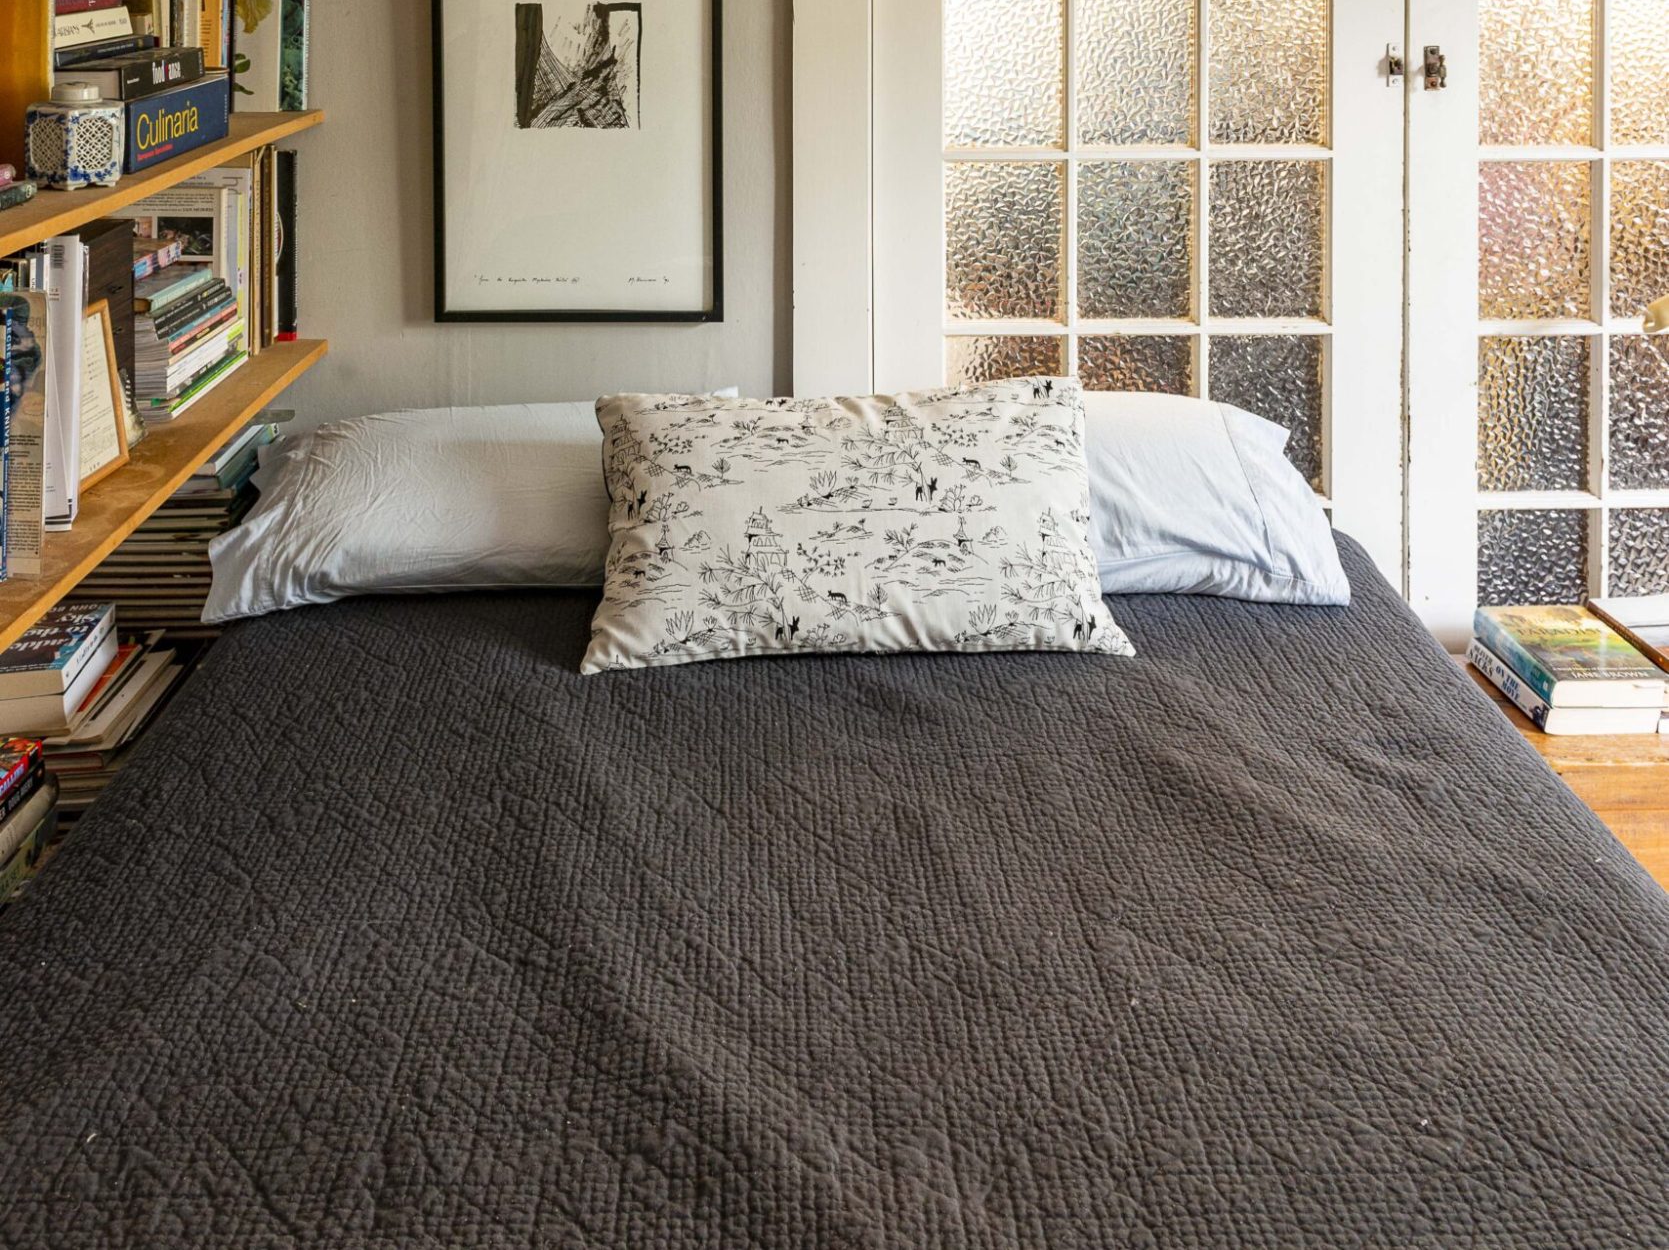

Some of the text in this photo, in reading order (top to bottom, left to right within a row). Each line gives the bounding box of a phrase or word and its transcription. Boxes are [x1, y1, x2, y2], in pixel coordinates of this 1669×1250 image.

[136, 100, 199, 150] Culinaria
[23, 626, 60, 638] the
[1469, 648, 1493, 677] SACKS
[1474, 644, 1493, 664] OLIVER
[1495, 665, 1519, 690] ON THE
[1571, 671, 1649, 679] JANE BROWN
[1501, 680, 1519, 701] MOVE
